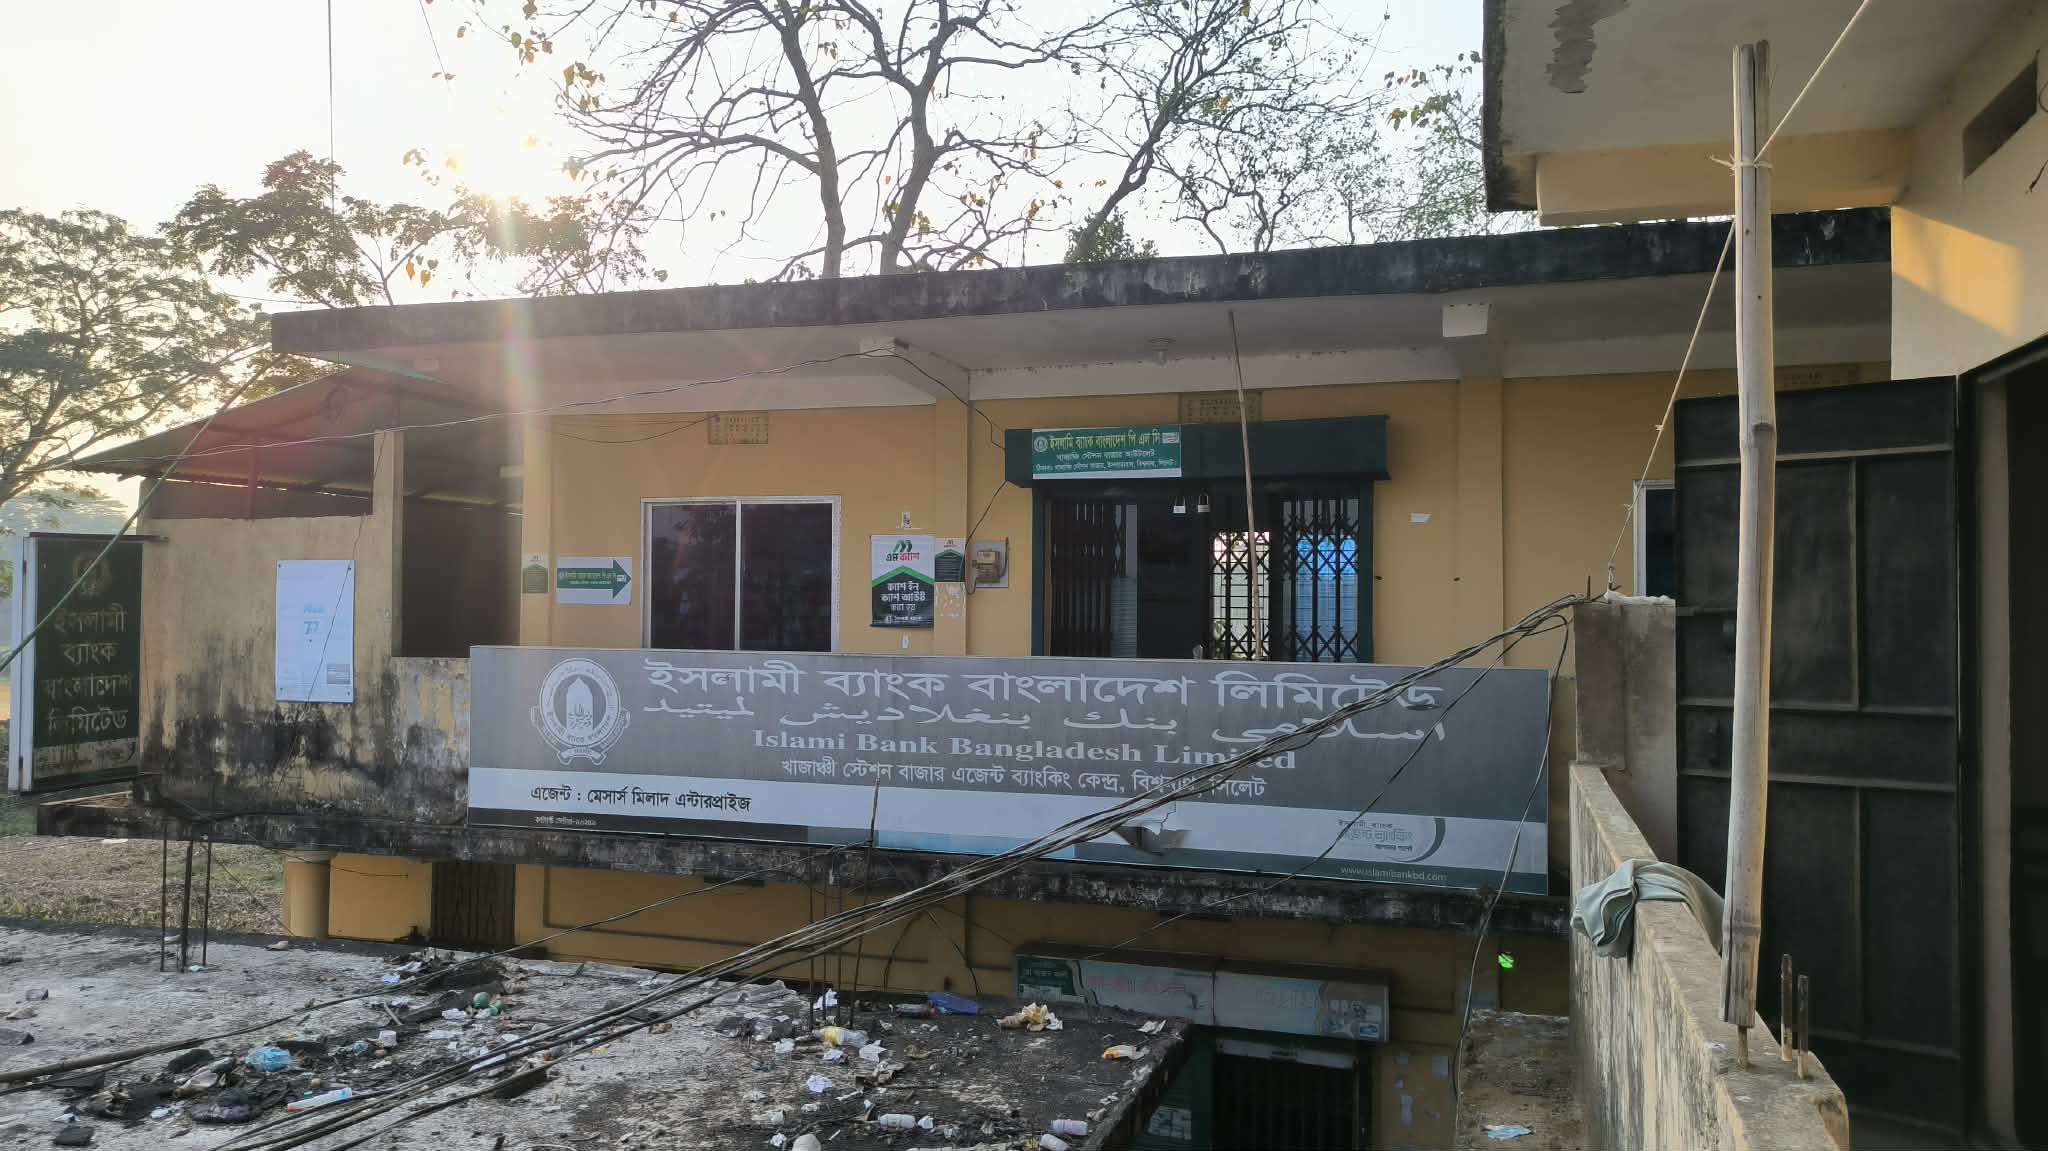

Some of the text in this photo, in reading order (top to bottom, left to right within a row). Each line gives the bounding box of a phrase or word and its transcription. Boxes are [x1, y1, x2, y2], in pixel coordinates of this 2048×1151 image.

[61, 641, 120, 665] ব্যাংক
[643, 658, 807, 695] ইসলামী
[816, 668, 950, 700] ব্যাংক
[960, 671, 1199, 705] বাংলাদেশ
[752, 729, 1297, 769] Islami Bank Bangladesh Limied
[843, 760, 893, 781] স্টেশন
[898, 764, 945, 783] বাজার
[952, 765, 1007, 785] এজেন্ট
[1011, 766, 1073, 789] ব্যাংকিং
[1078, 771, 1125, 793] কেন্দ্র,
[1207, 773, 1268, 798] সিলেট
[531, 784, 573, 801] এজেন্ট
[587, 785, 629, 804] মেসার্স
[631, 786, 672, 808] মিলাদ
[675, 789, 753, 812] এন্টারপ্রাইজ
[1340, 865, 1448, 882] www.islamibankbd.com
